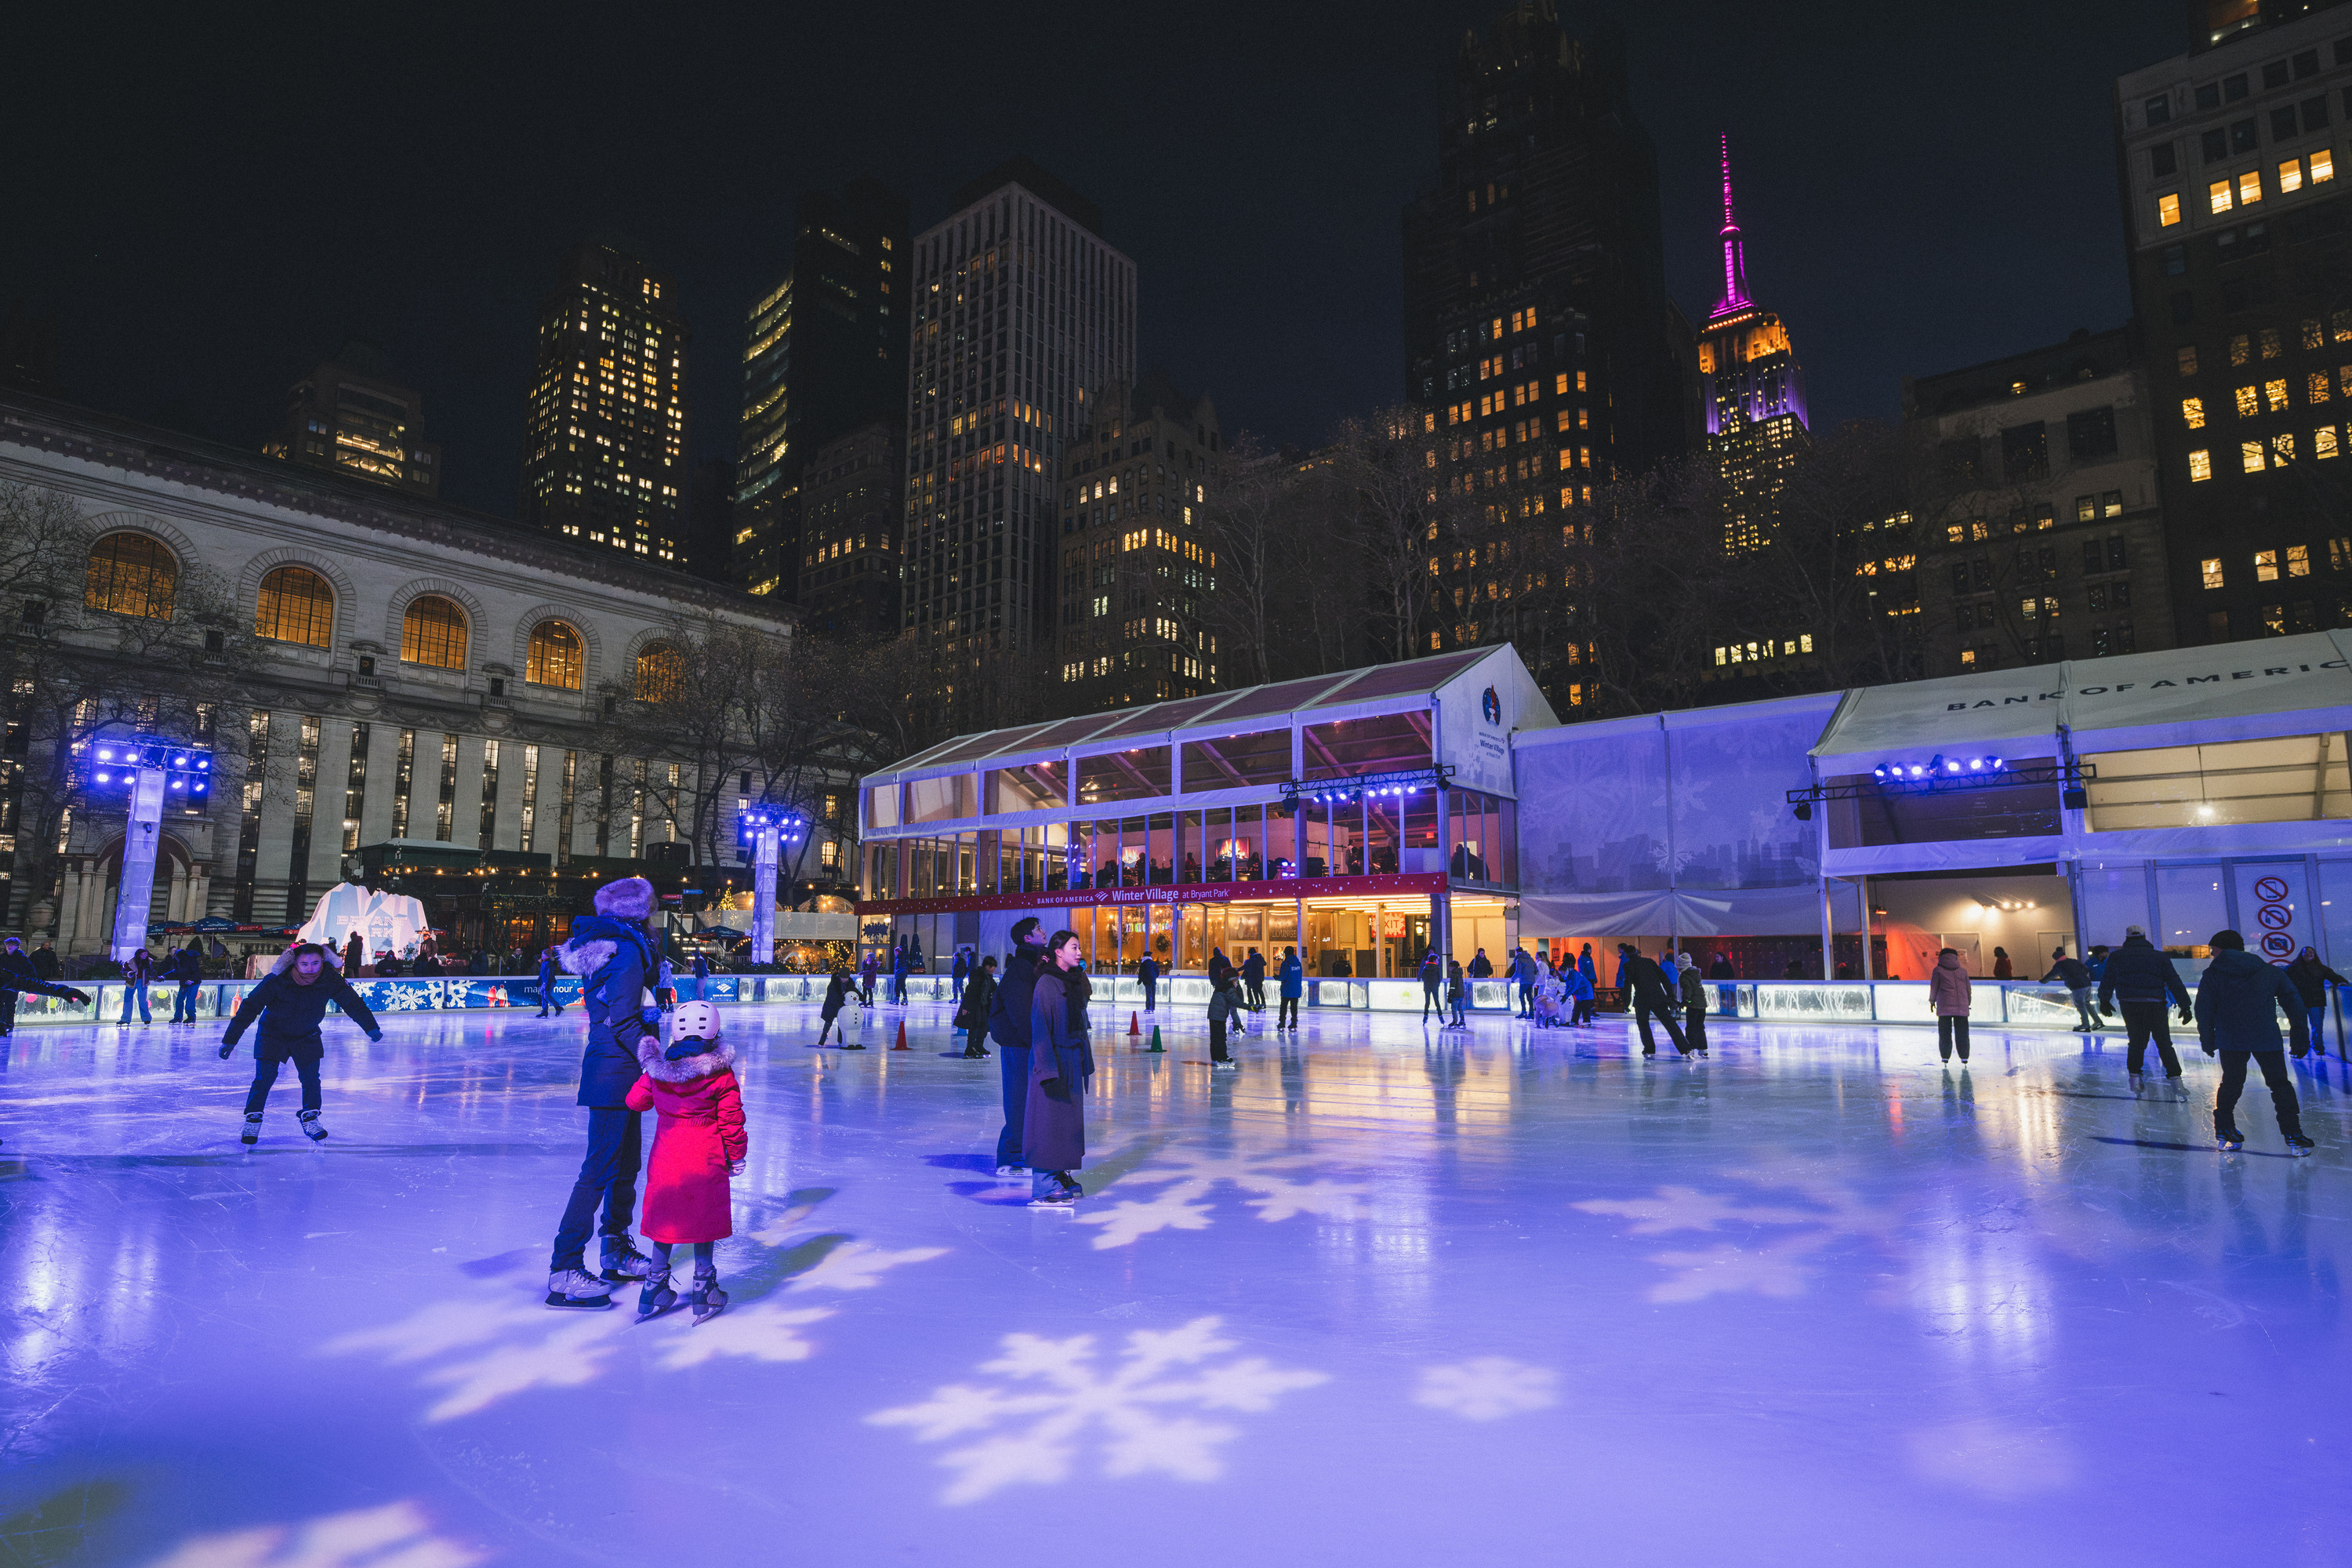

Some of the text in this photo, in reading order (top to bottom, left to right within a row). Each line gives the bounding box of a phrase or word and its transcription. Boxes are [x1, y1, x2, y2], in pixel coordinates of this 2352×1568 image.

[1947, 659, 2350, 712] BANK OF AMERIC
[1480, 739, 1494, 750] Winter
[1494, 744, 1504, 756] Village
[1112, 891, 1145, 902] Winter
[1145, 888, 1179, 902] Village
[1191, 890, 1213, 900] Bryant
[1214, 888, 1229, 898] Park
[1385, 920, 1399, 929] XIT
